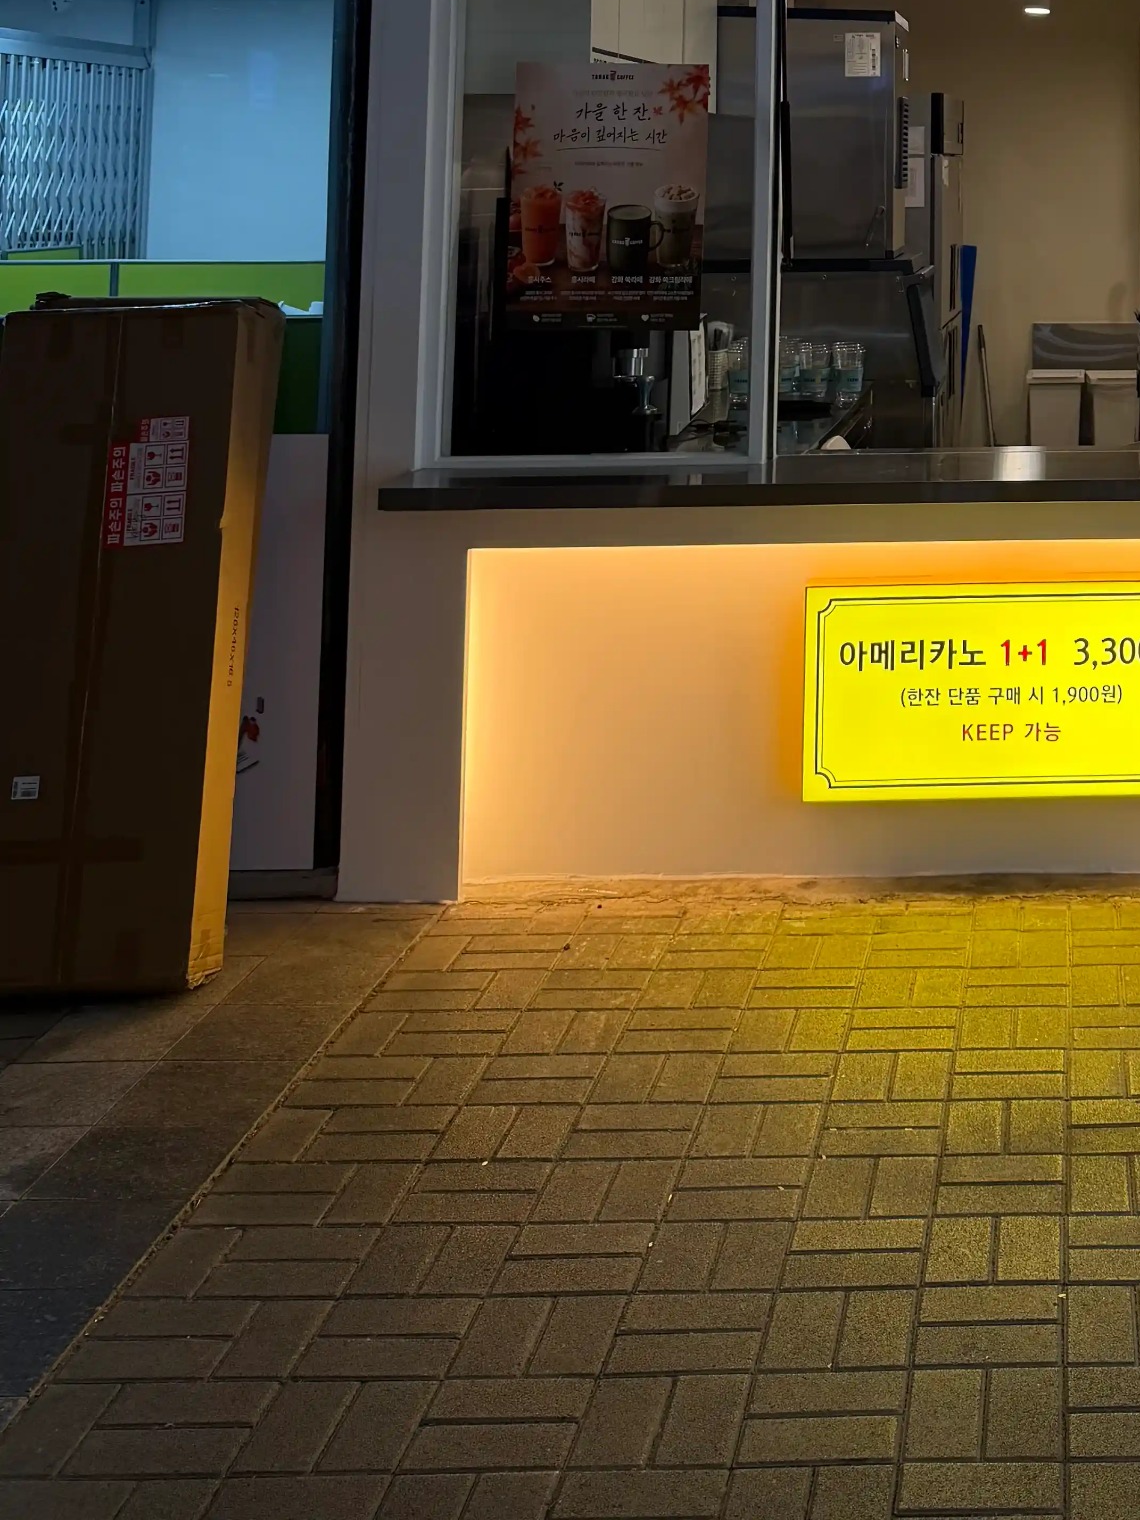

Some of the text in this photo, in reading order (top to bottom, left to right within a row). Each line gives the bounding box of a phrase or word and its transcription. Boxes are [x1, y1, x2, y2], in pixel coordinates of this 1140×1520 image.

[575, 102, 608, 121] 가을
[613, 101, 628, 121] 한
[553, 125, 668, 144] 마음이 깊어지는 시간
[107, 446, 126, 544] 파손주의 파손주의
[839, 639, 987, 672] 아메리카노
[1000, 639, 1048, 667] 1+1
[900, 684, 1123, 707] (한잔 단품 구매 시 1,900원)
[962, 722, 1062, 742] KEEP 가능
